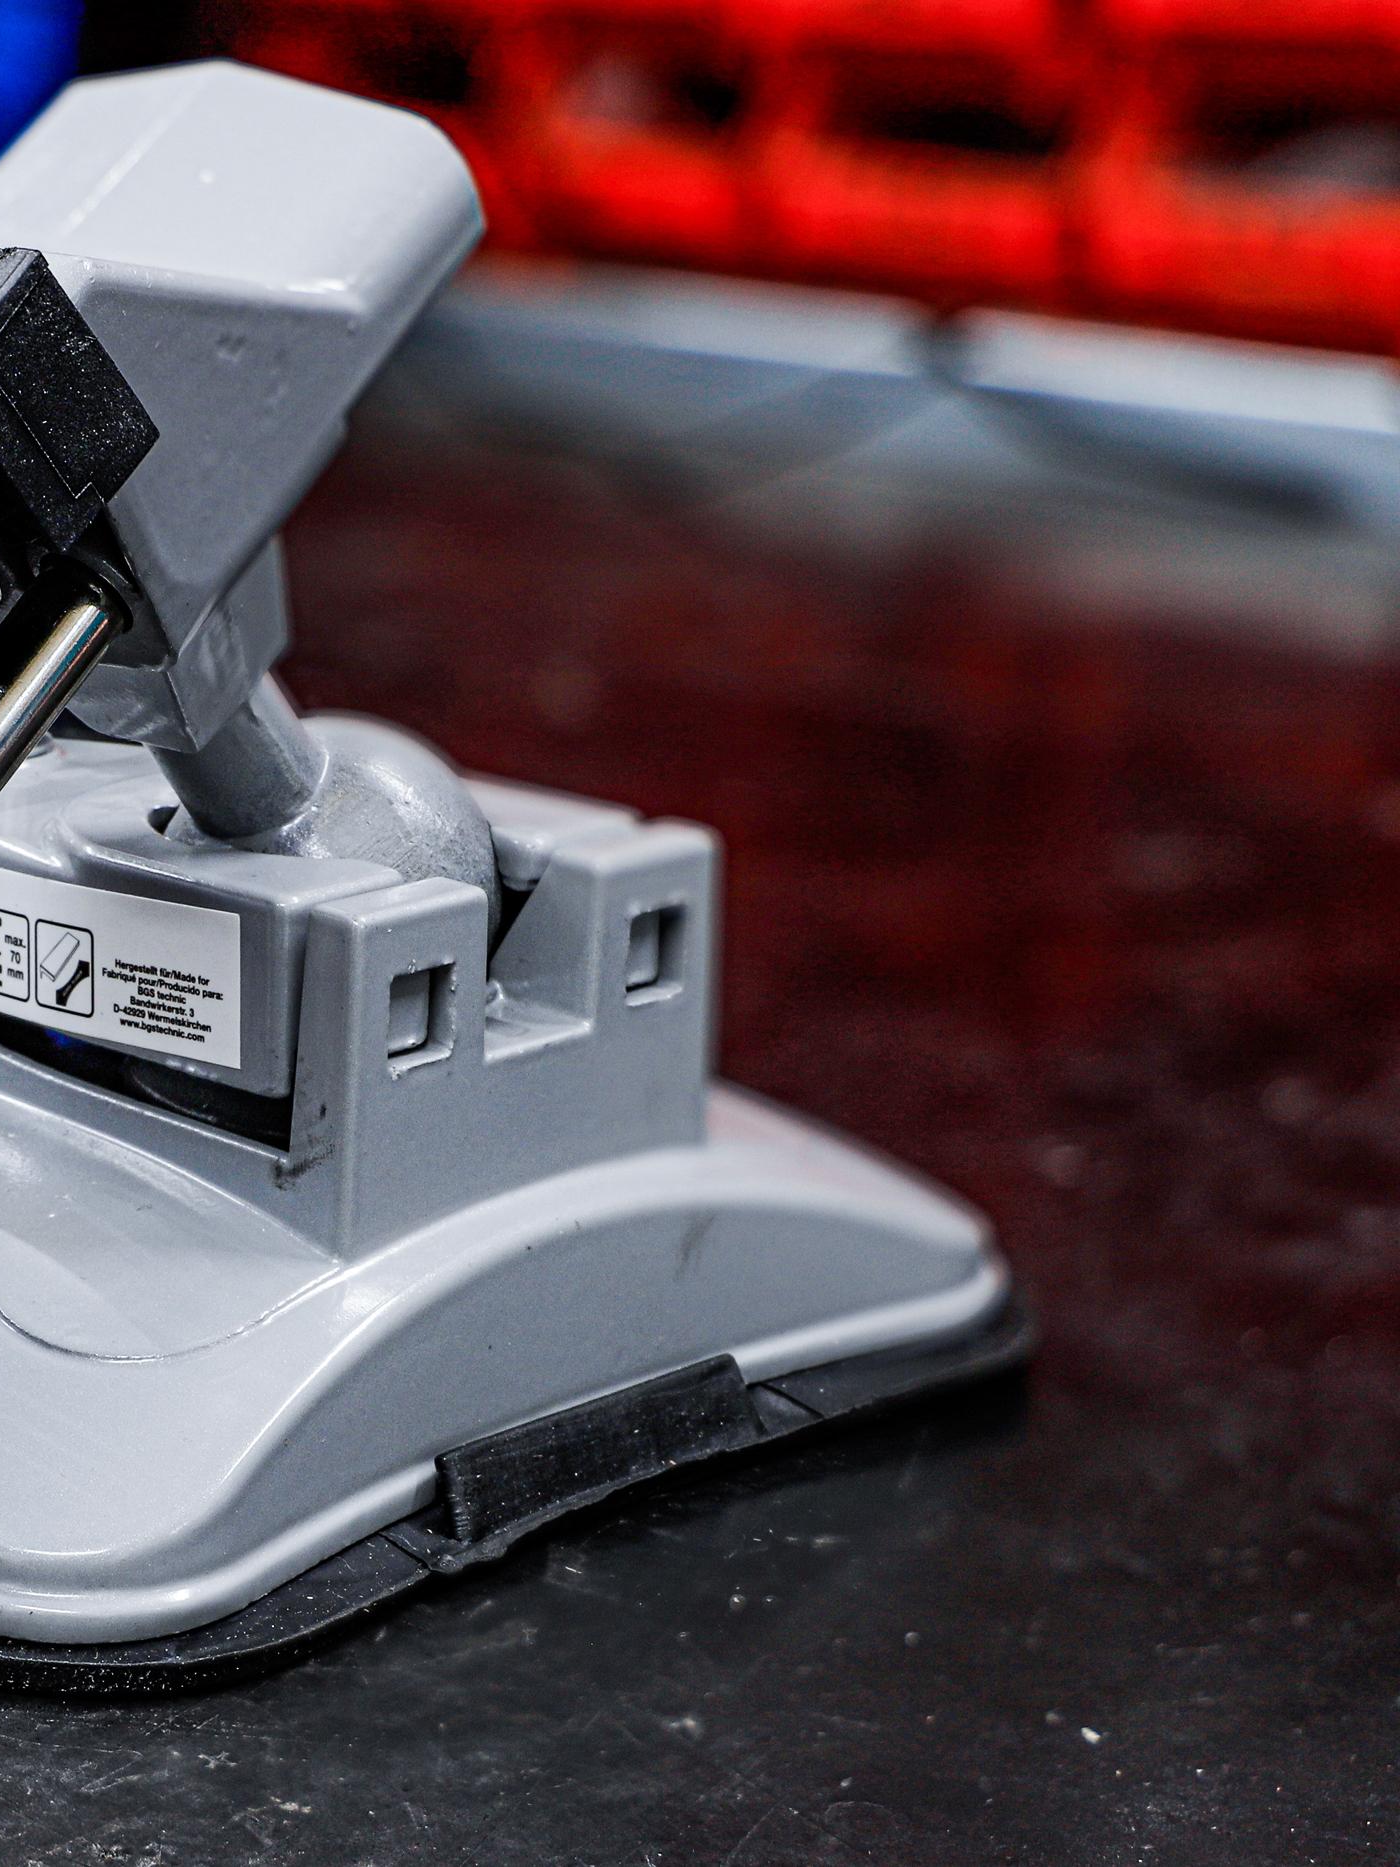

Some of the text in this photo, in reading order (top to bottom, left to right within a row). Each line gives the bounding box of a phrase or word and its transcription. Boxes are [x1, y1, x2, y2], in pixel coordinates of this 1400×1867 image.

[4, 934, 26, 949] max.
[10, 950, 21, 964] 70
[7, 967, 24, 980] mm
[115, 959, 210, 986] Hergestellt für/Made for
[102, 967, 223, 1001] Fabriqué pour/Producido para:
[138, 986, 186, 1005] BGS technic
[130, 996, 195, 1017] Bandwirkerstr. 3
[113, 1003, 212, 1032] D-42929 Wermelskirchen
[120, 1018, 205, 1042] www.bgstechnic.com
